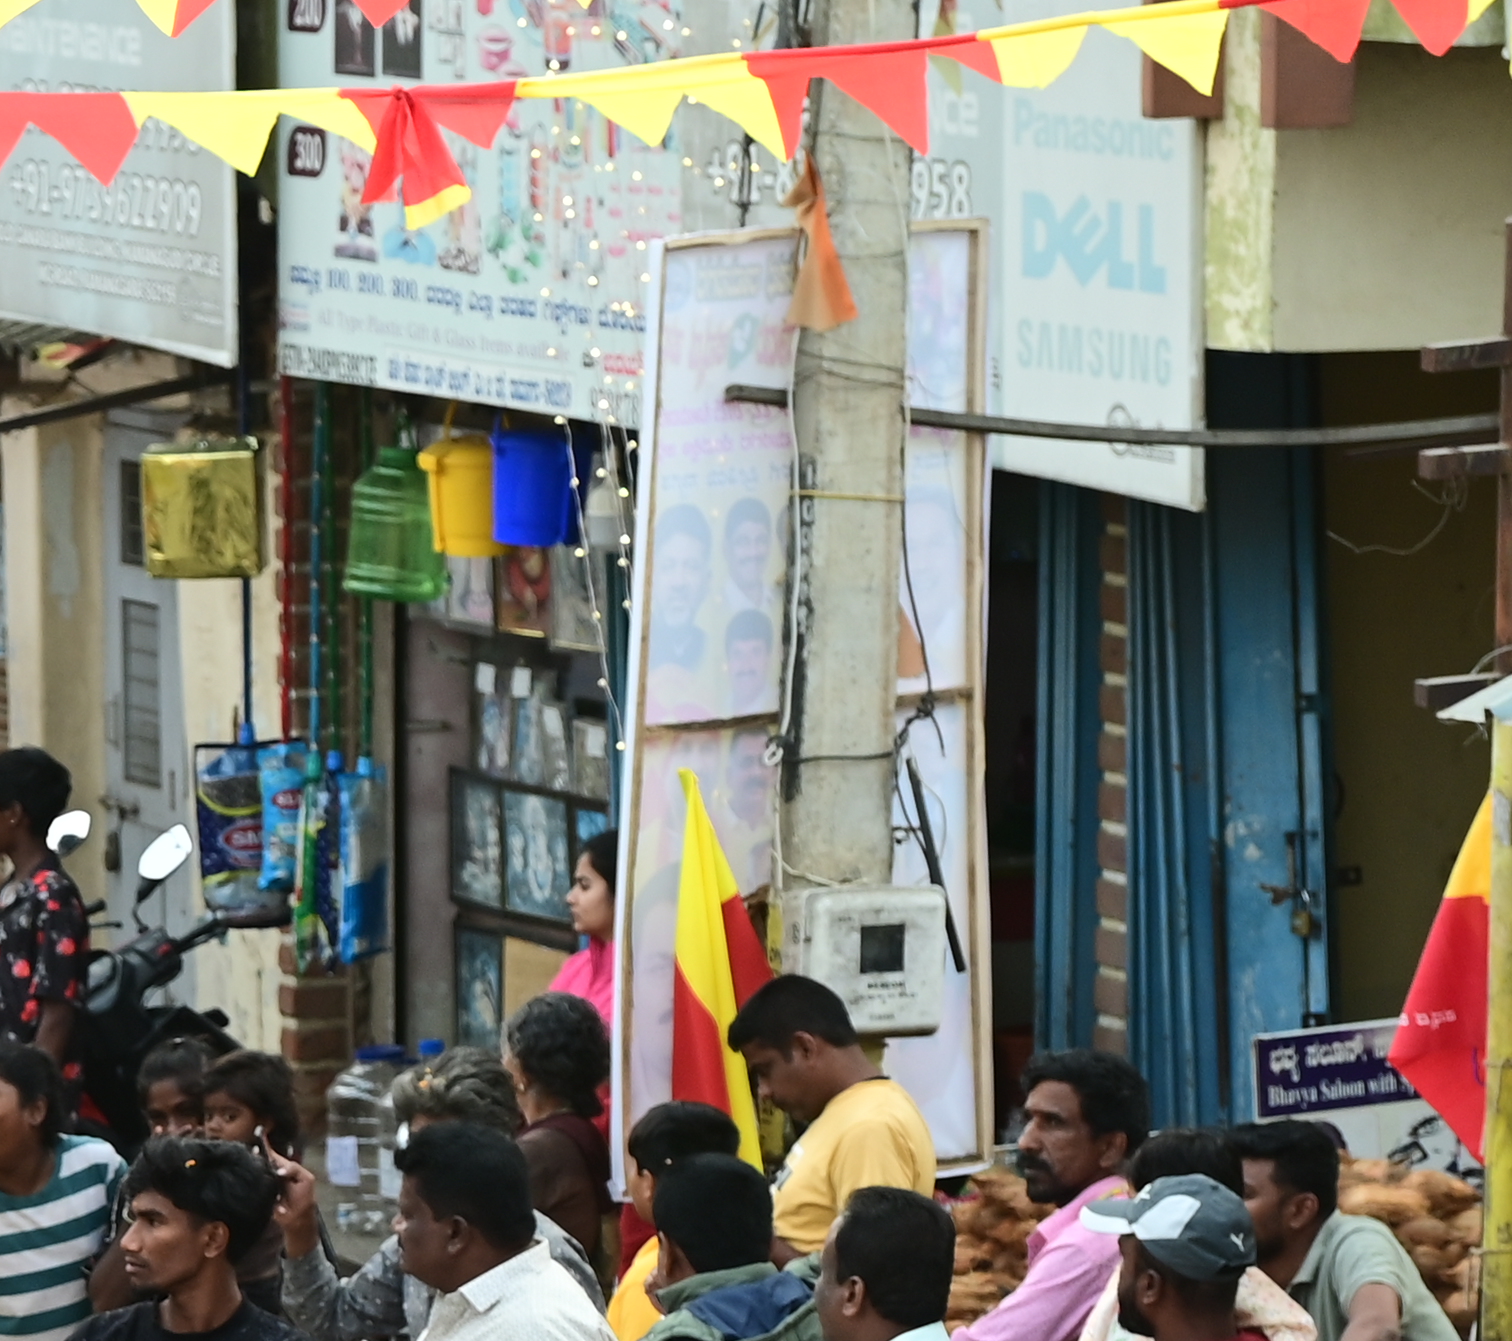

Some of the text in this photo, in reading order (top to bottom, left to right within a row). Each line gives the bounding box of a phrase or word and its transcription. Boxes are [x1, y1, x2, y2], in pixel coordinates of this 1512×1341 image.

[293, 132, 324, 171] 300
[1014, 95, 1174, 163] Panasonic
[1021, 190, 1167, 295] DELL
[1016, 317, 1172, 387] SAMSUNG
[1267, 1083, 1319, 1110] Bhavya
[1319, 1076, 1366, 1102] Saloon
[1367, 1072, 1398, 1095] with
